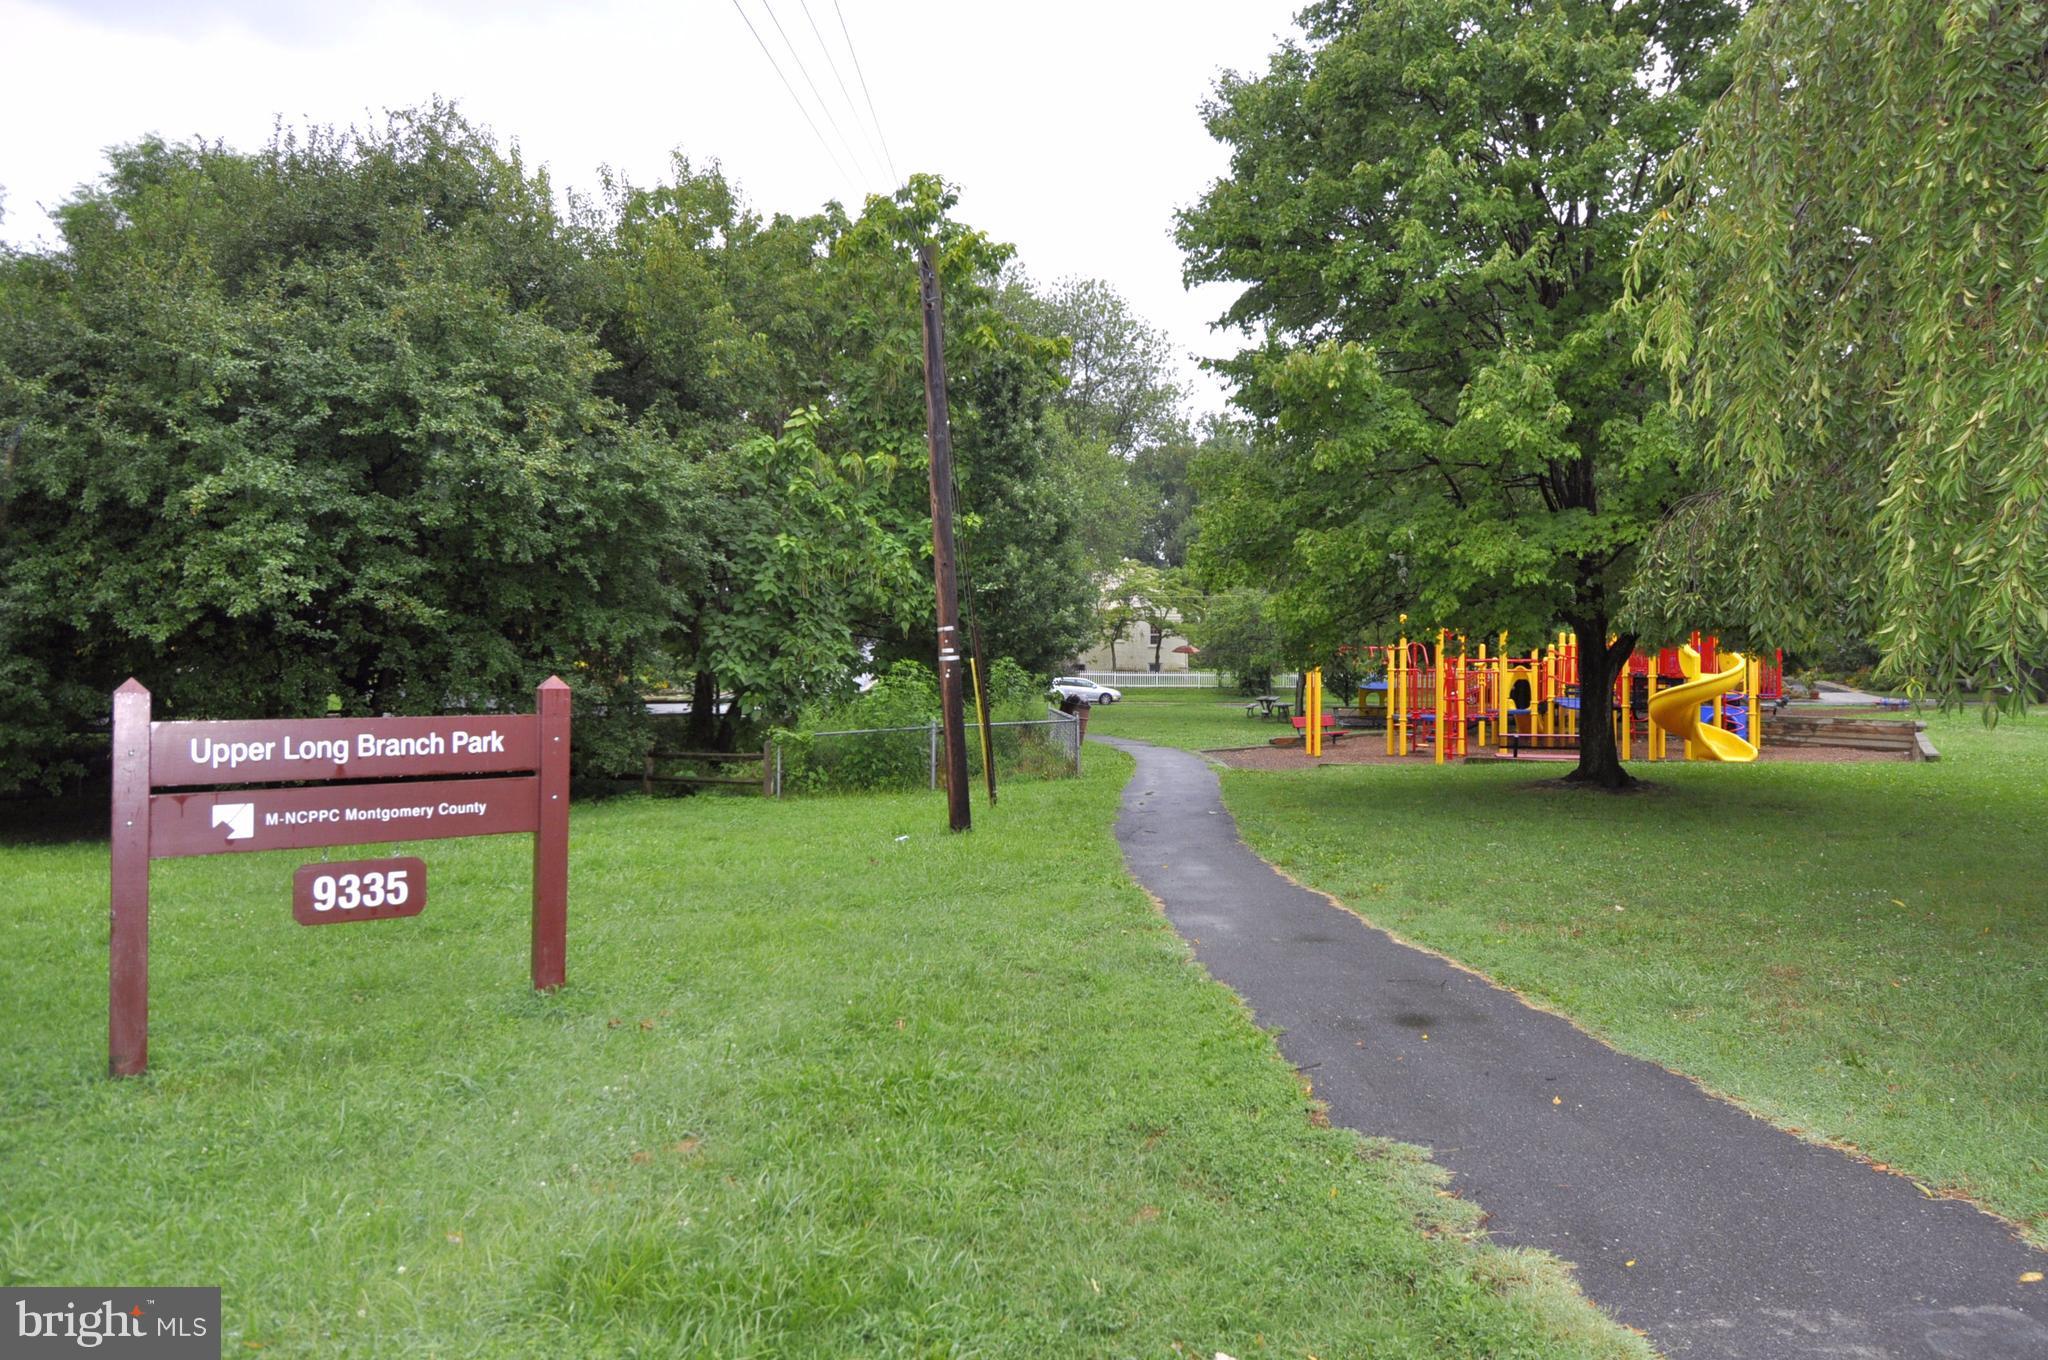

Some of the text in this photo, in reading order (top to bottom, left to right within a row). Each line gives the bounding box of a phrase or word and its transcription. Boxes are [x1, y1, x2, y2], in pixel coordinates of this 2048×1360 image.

[190, 730, 505, 768] Upper Long Branch Park
[265, 801, 487, 826] M-NCPPC Montgomery County
[313, 870, 409, 911] 9335
